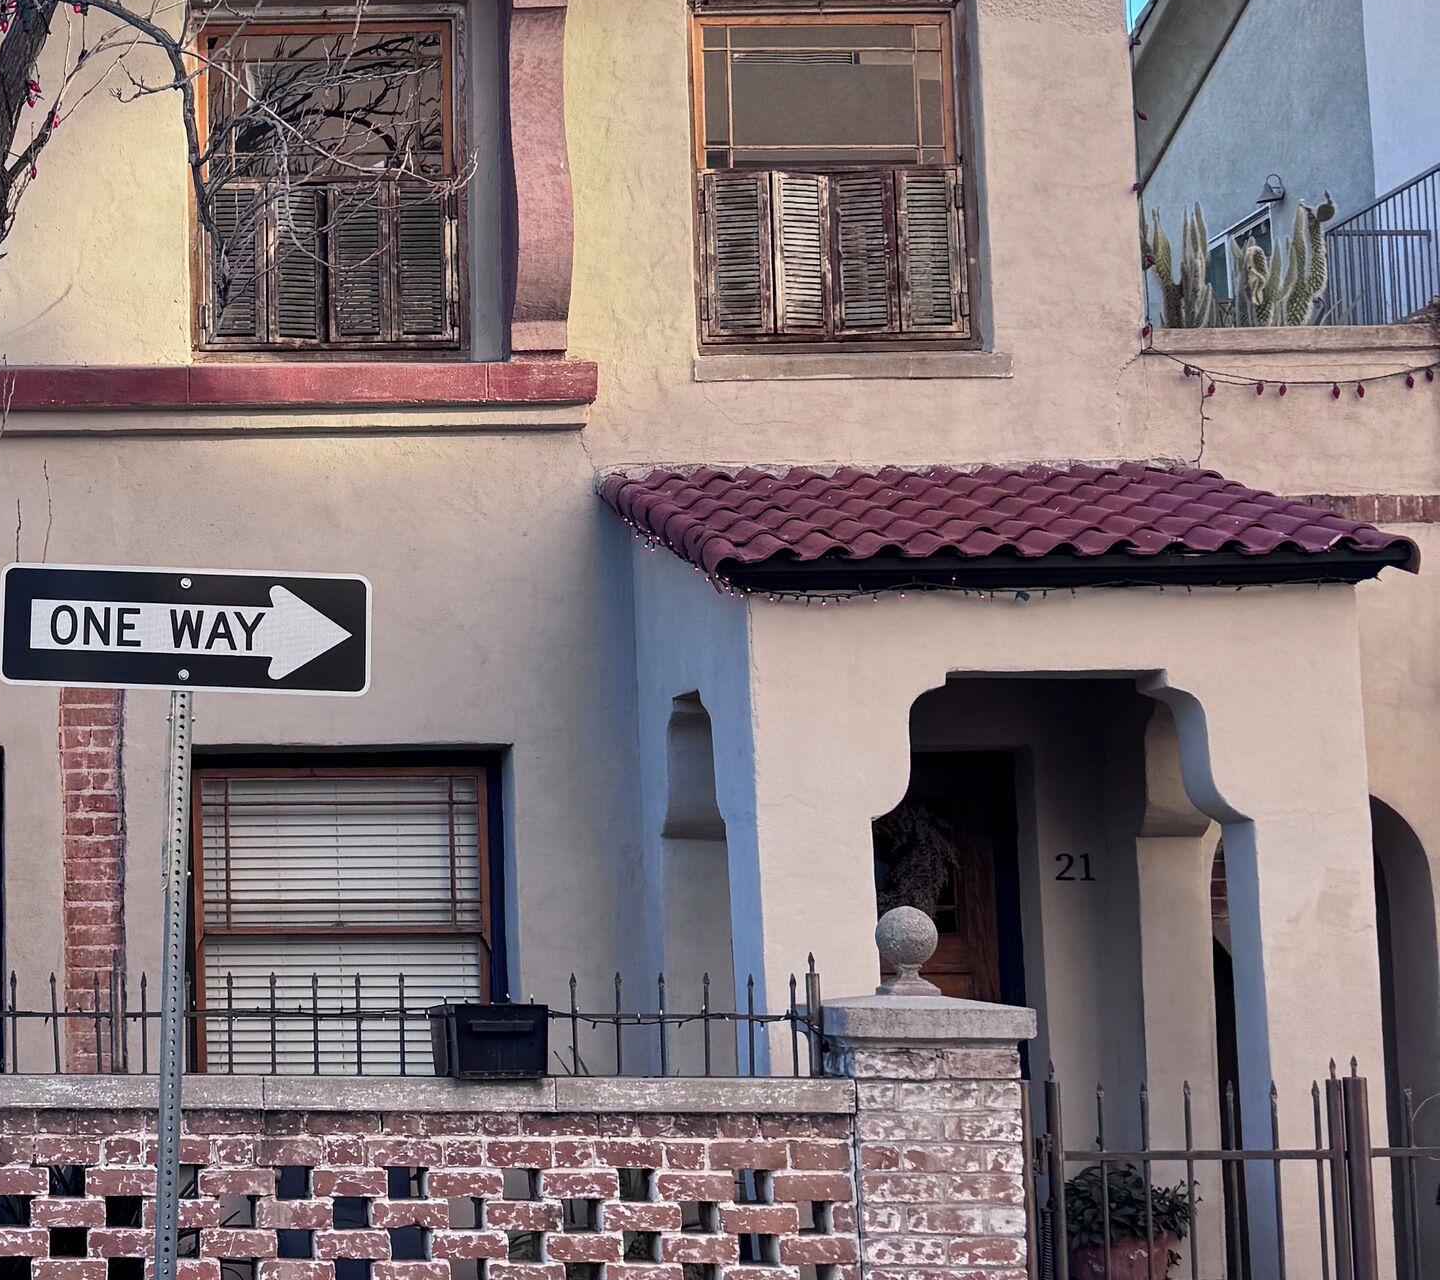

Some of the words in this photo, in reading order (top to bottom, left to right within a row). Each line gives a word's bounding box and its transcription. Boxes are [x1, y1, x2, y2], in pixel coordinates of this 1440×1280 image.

[49, 604, 142, 647] ONE
[169, 608, 266, 651] WAY
[1055, 852, 1096, 881] 21
